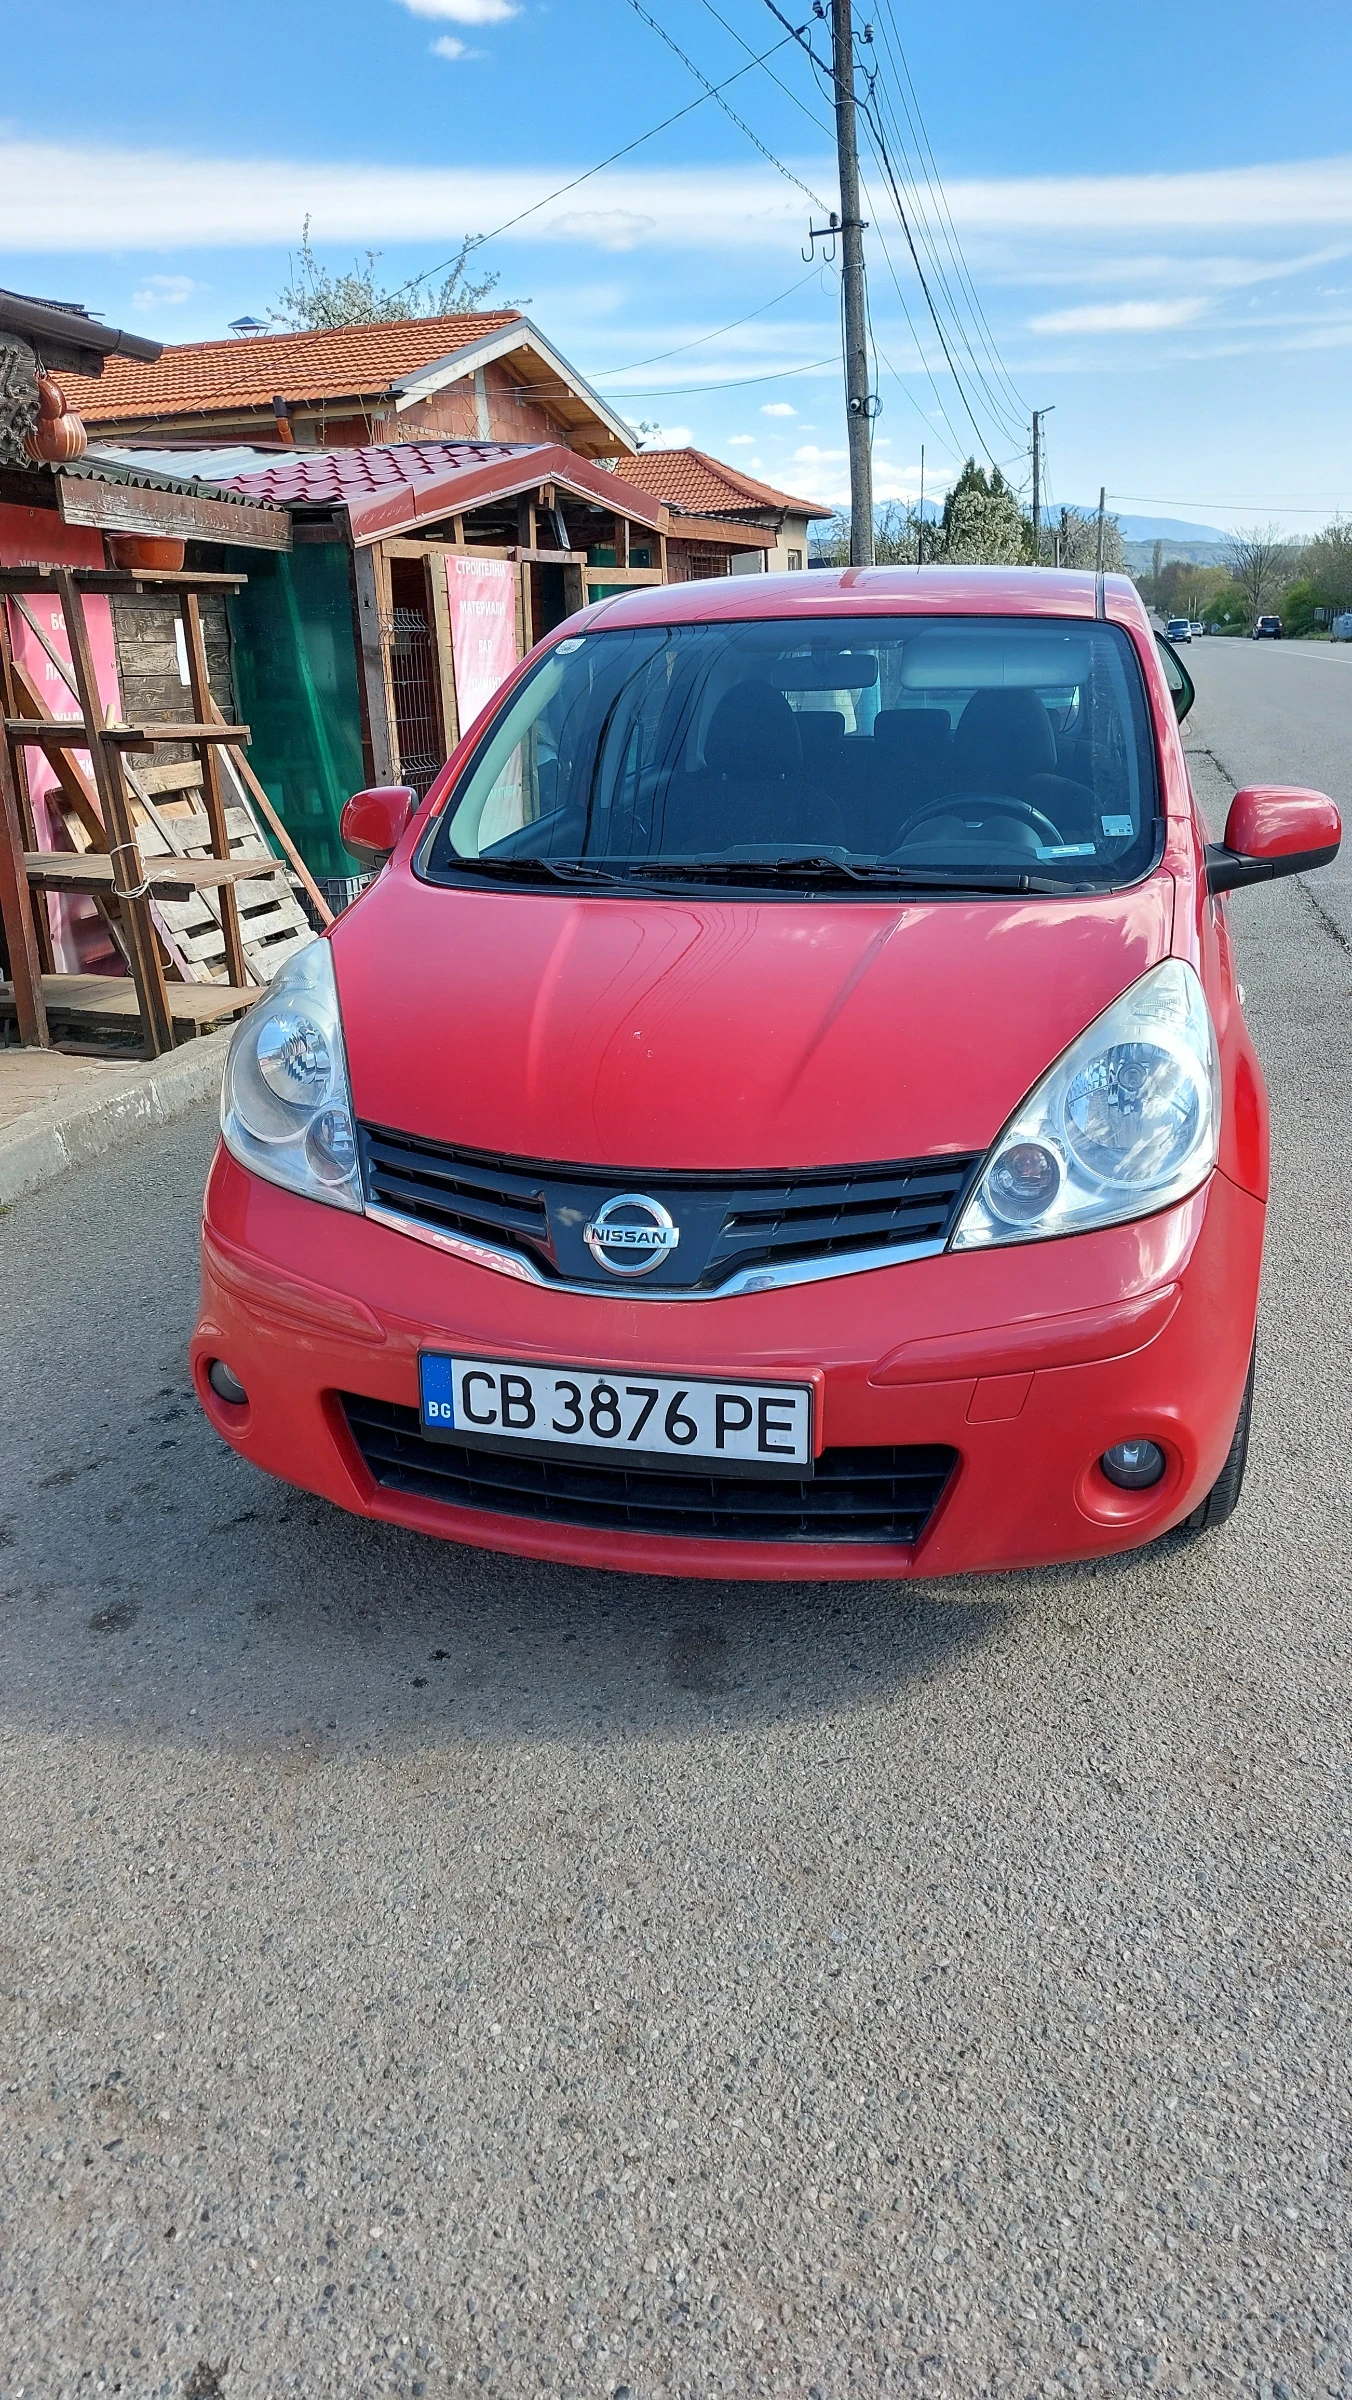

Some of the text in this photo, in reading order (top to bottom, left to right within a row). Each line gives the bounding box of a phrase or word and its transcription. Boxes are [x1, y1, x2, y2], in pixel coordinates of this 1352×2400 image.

[455, 560, 506, 577] СТРОИТЕЛНИ
[460, 600, 506, 616] МАТЕРИАЛИ
[478, 639, 493, 653] ВАР
[592, 1228, 667, 1244] NISSAN
[428, 1401, 451, 1418] BG
[462, 1370, 796, 1455] CB 3876 PE
